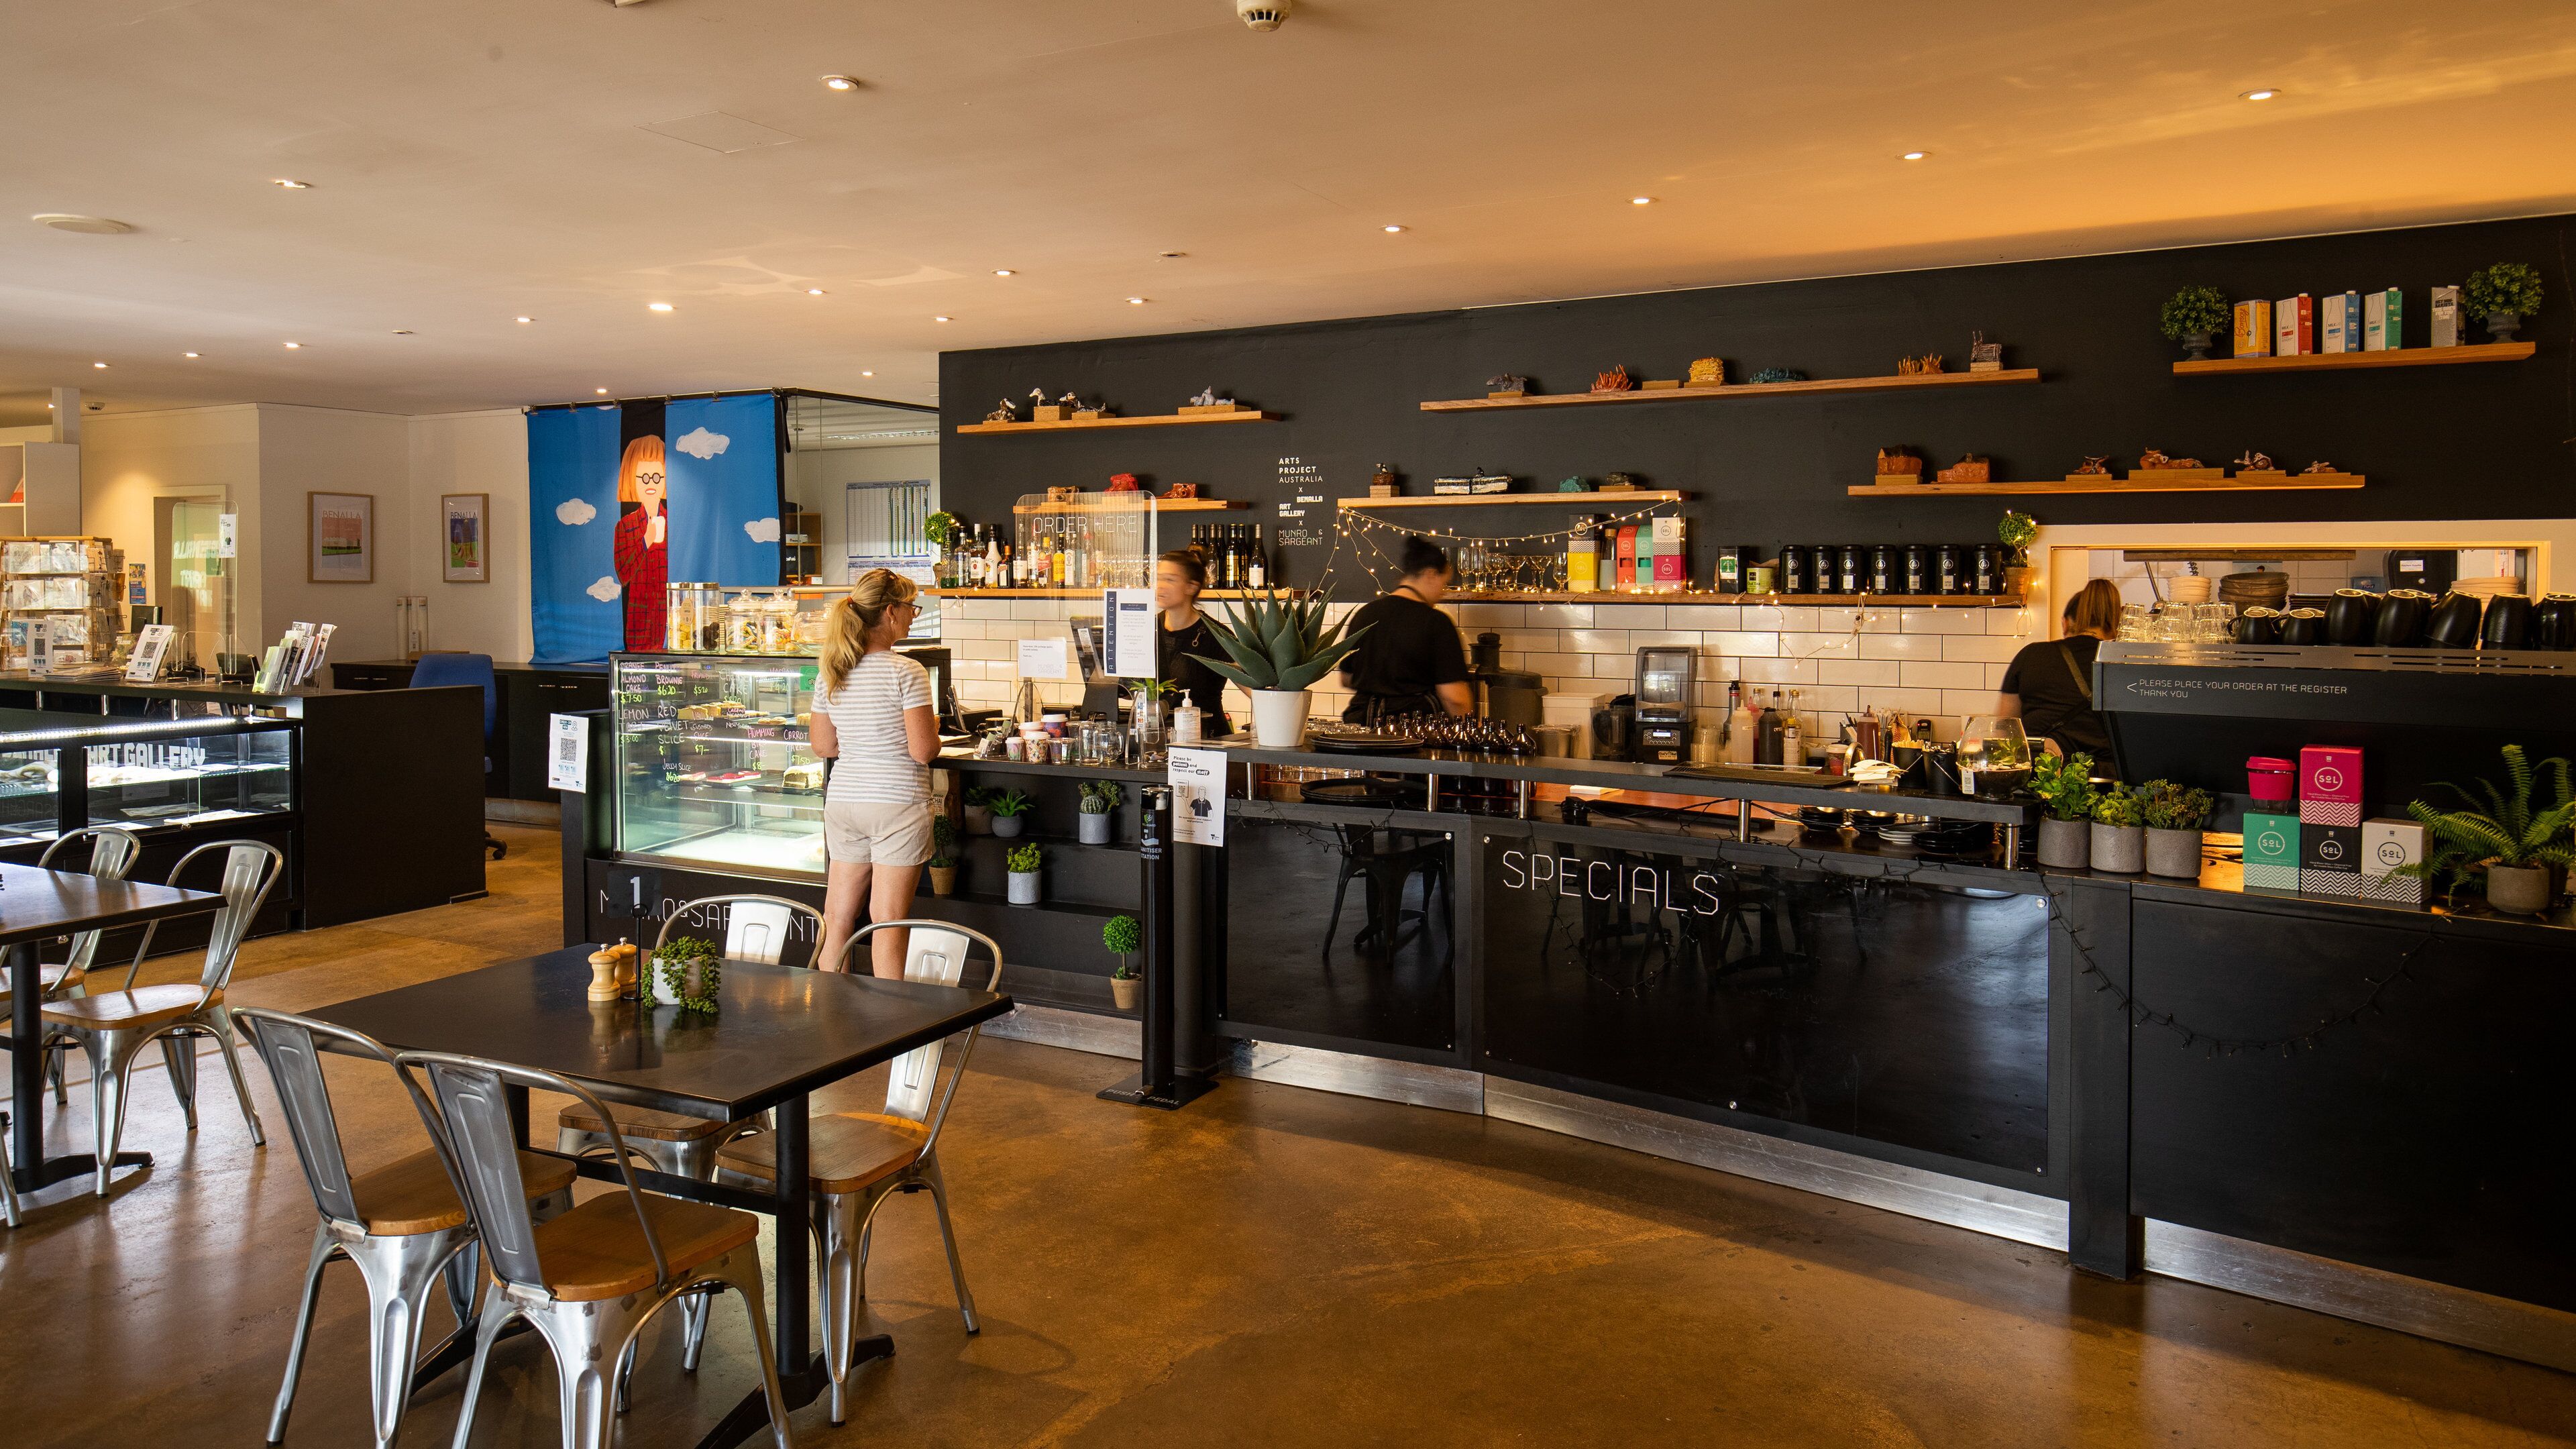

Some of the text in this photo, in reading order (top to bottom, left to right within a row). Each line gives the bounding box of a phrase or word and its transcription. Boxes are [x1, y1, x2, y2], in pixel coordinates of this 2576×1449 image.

[1279, 457, 1300, 465] ARTS
[1279, 466, 1316, 474] PROJECT
[323, 510, 361, 519] BENALLA
[1033, 516, 1138, 534] ORDER HERE
[1279, 529, 1307, 538] MUNRO
[1279, 537, 1323, 546] SARGEANT
[621, 674, 647, 684] ALMOND
[655, 674, 683, 685] BROWNIE
[626, 684, 642, 693] CAKE
[723, 683, 748, 695] CAKE
[2139, 679, 2172, 688] PLEASE
[2175, 680, 2202, 688] PLACE
[2205, 682, 2230, 690] YOUR
[2233, 682, 2263, 691] ORDER
[2280, 684, 2298, 692] THE
[2300, 684, 2347, 694] REGISTER
[2139, 689, 2188, 698] THANK YOU
[619, 708, 649, 720] LEMON
[657, 705, 677, 718] RED
[658, 733, 685, 745] SLICE
[747, 728, 774, 739] HUMMING
[784, 729, 808, 741] CARROT
[88, 743, 121, 767] ART
[124, 742, 206, 769] GALLERY
[749, 749, 767, 759] CAKE
[663, 758, 692, 772] JELLY SLICE
[1503, 850, 1719, 916] SPECIALS
[630, 876, 641, 908] 1
